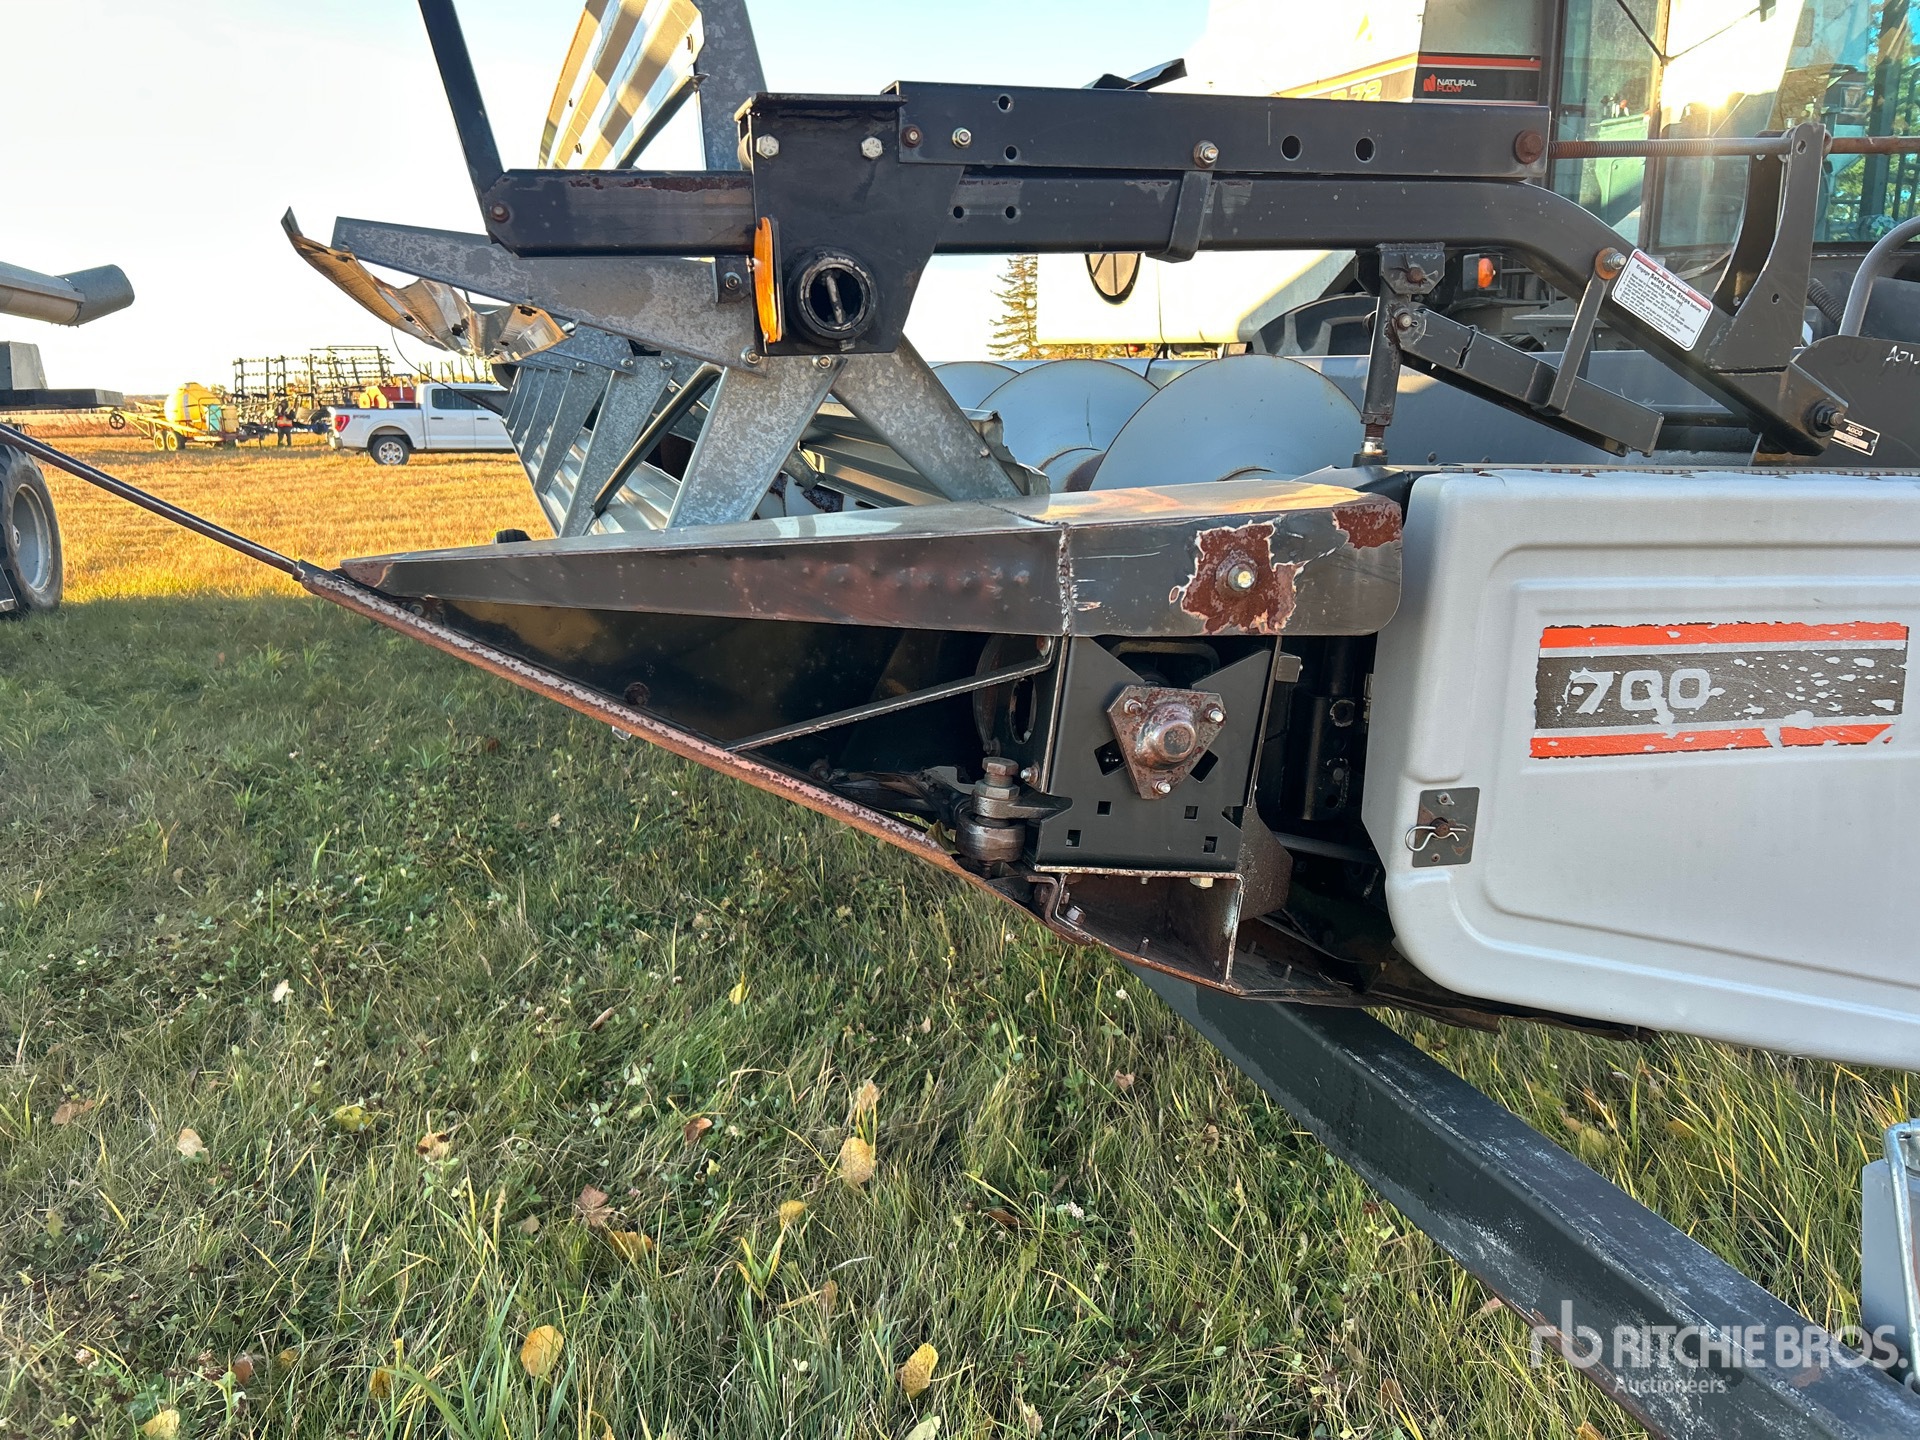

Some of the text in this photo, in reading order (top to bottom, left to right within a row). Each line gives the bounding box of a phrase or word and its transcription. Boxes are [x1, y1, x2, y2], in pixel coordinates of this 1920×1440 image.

[1437, 78, 1477, 87] NATURAL
[1437, 85, 1463, 93] FLOW
[1636, 263, 1702, 312] Engage Safety Ram Stops before
[1651, 281, 1664, 294] working
[1665, 291, 1676, 301] under
[1846, 426, 1863, 436] AGCO
[1567, 667, 1711, 714] 700
